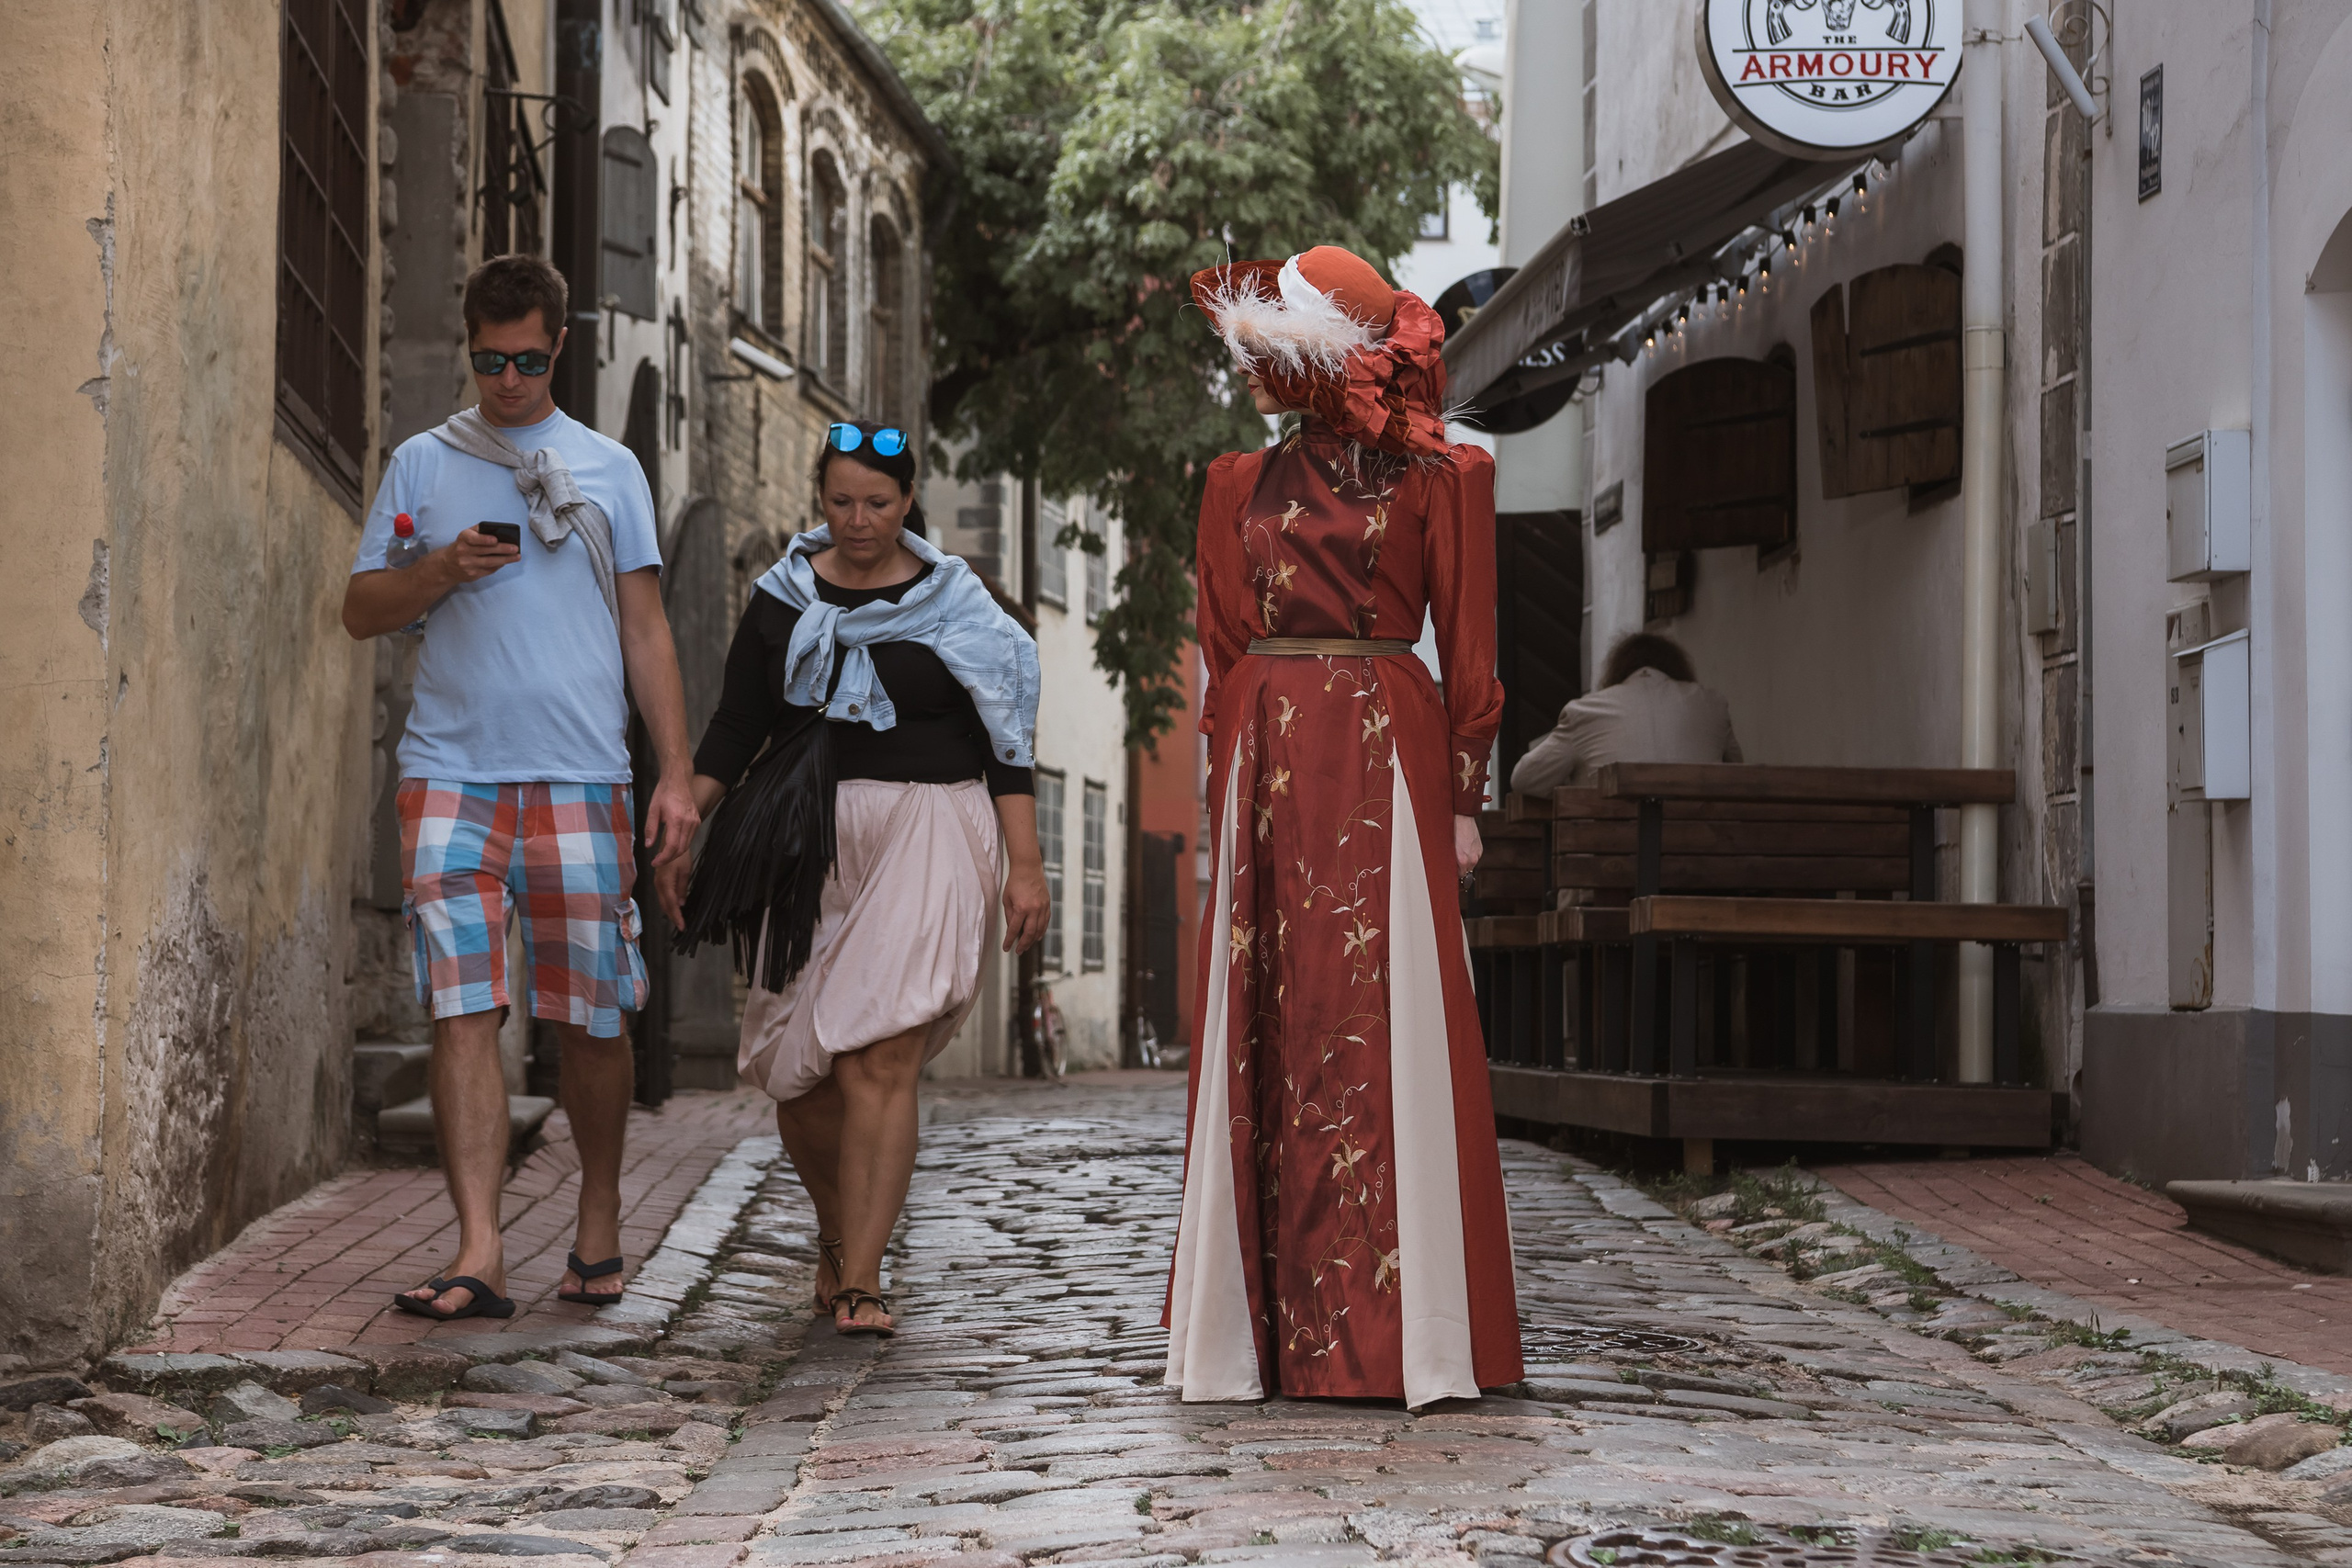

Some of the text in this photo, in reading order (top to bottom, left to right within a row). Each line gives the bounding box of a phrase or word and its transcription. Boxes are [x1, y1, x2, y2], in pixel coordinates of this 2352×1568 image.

[1822, 35, 1858, 45] THE
[1739, 51, 1939, 81] ARMOURY
[1808, 82, 1873, 101] BAR
